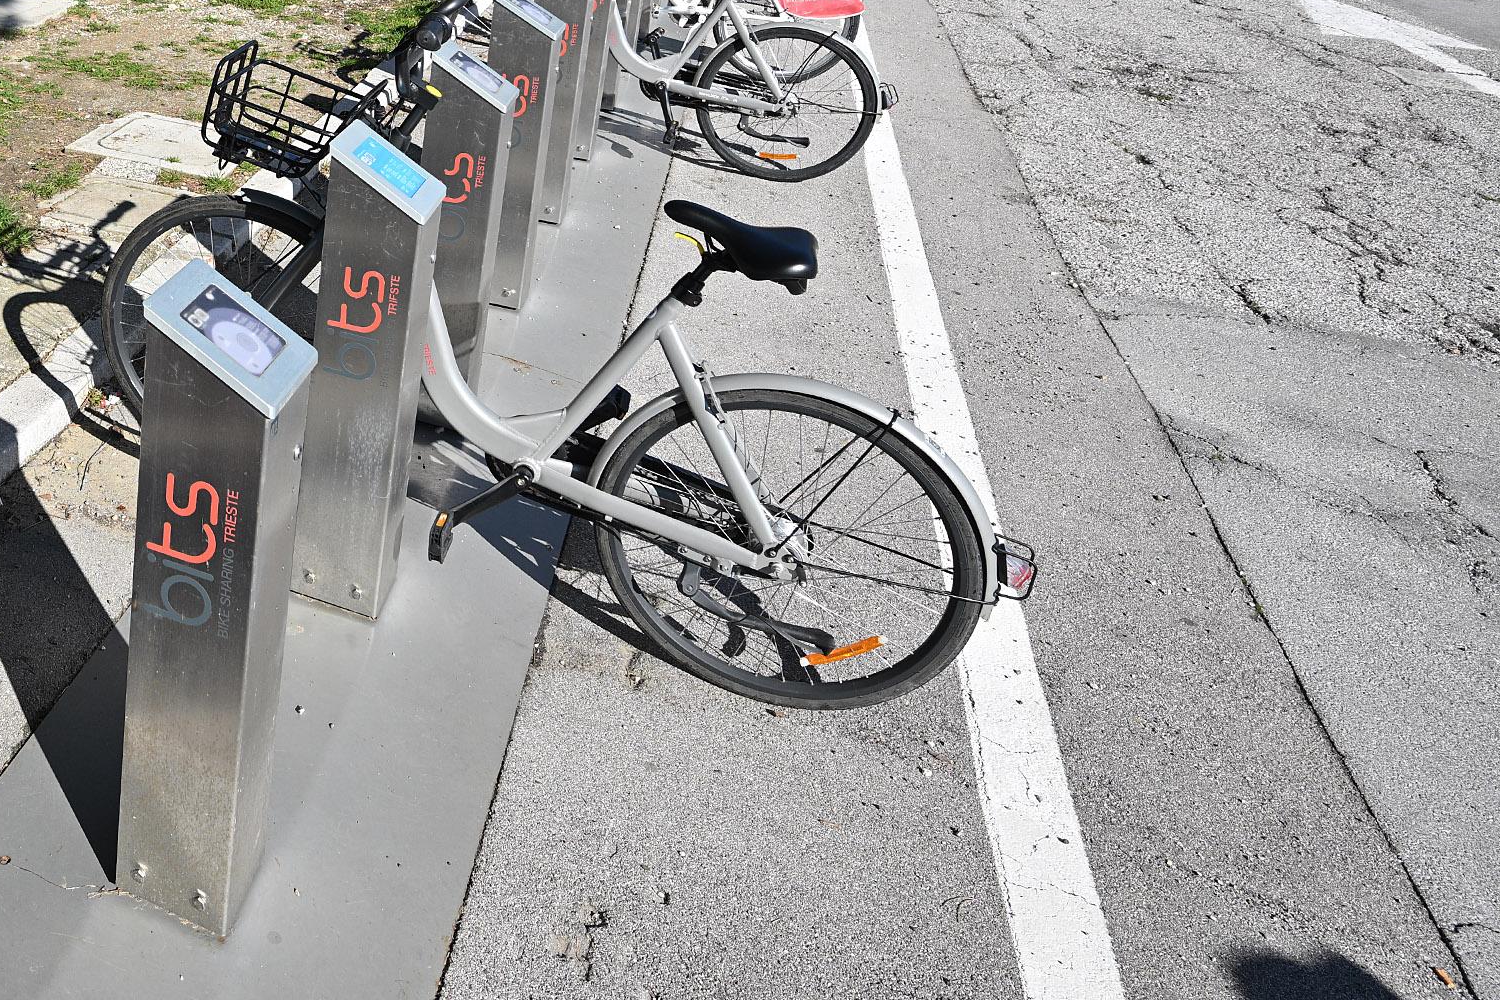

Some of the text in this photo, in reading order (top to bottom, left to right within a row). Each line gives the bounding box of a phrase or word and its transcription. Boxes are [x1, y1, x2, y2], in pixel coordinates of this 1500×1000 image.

[530, 76, 540, 104] TRIESTE
[475, 155, 487, 189] TRIESTE
[323, 266, 386, 381] bits
[140, 472, 220, 628] bits
[216, 489, 239, 640] BIKE SHARING TRIESTE
